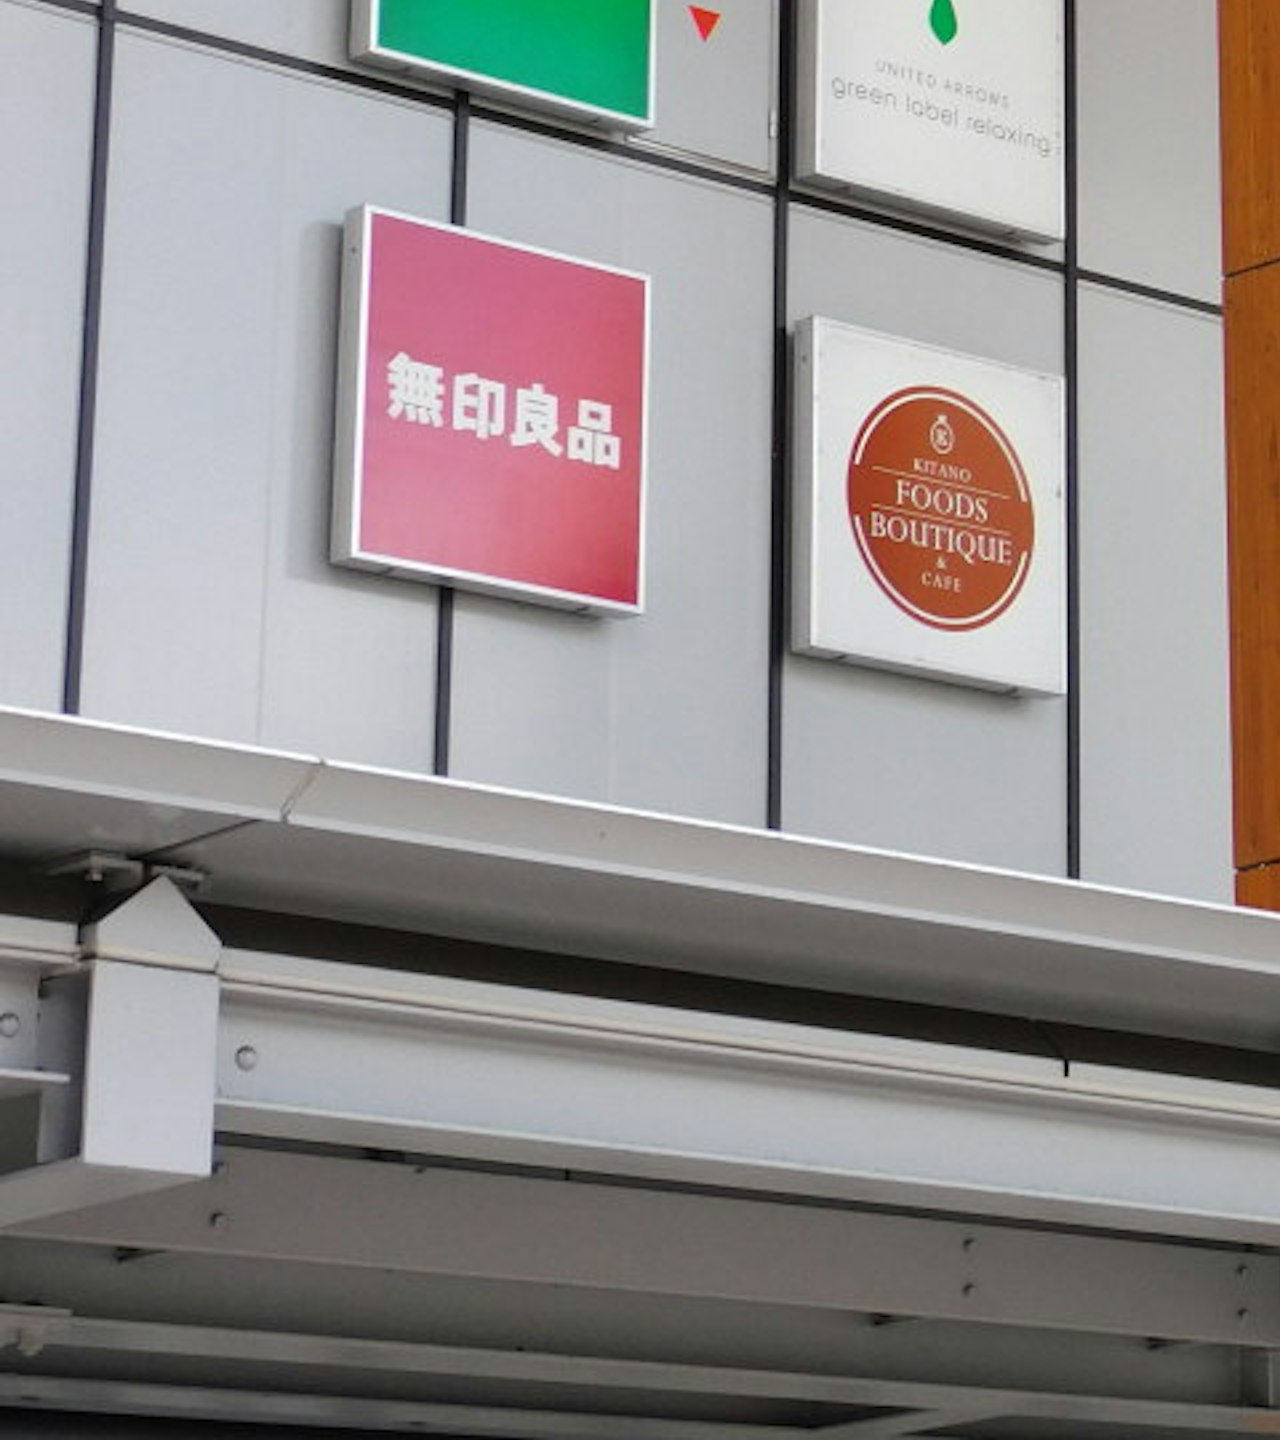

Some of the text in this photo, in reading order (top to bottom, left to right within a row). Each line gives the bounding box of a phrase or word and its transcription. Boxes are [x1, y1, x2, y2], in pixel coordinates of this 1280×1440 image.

[876, 59, 1009, 109] UNITED ARROWS
[831, 76, 1051, 158] green label relaxing
[386, 351, 622, 471] 無印良品
[913, 458, 972, 484] KITANO
[896, 479, 989, 523] FOODS
[870, 510, 1013, 566] BOUTIQUE
[921, 570, 961, 593] CAFE
